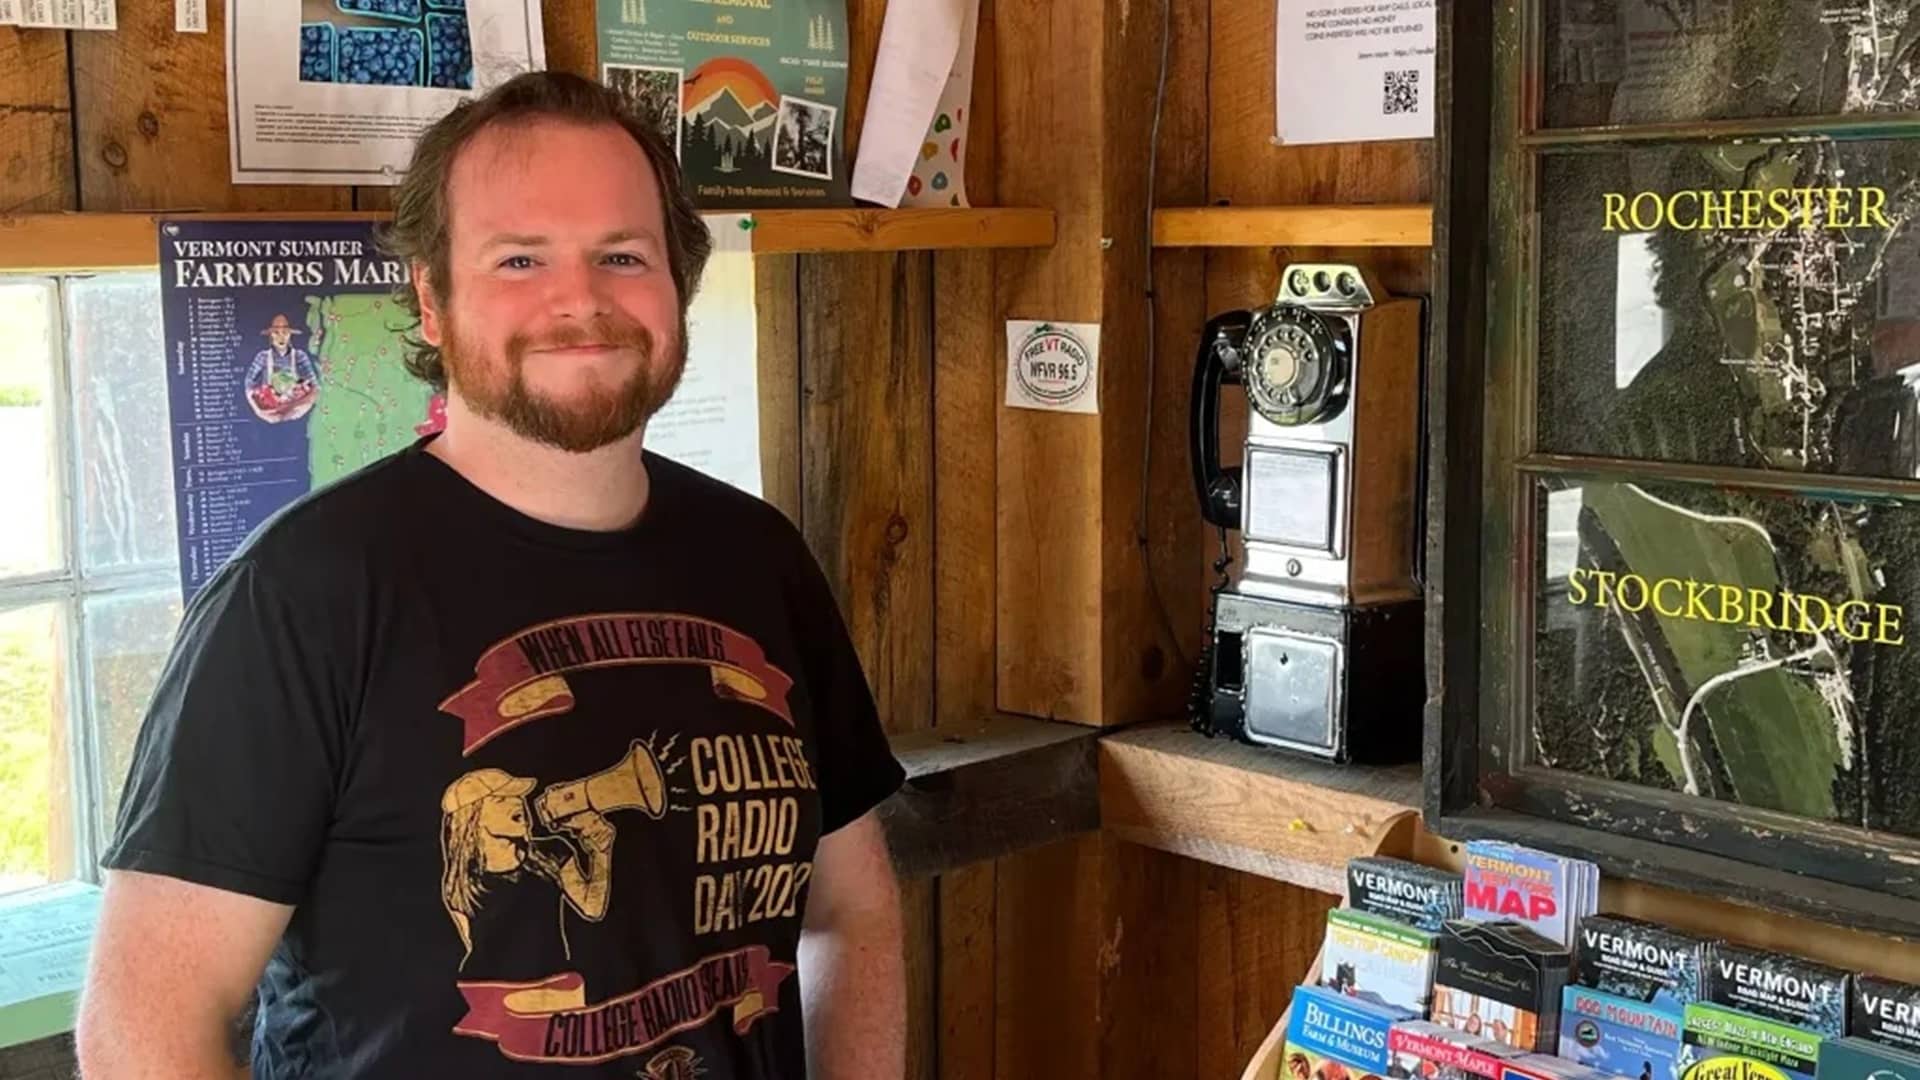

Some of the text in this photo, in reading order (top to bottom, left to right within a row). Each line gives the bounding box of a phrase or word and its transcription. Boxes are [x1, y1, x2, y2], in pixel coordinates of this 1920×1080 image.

[687, 30, 771, 47] OUTDOOR SERVICES
[1602, 186, 1890, 232] ROCHESTER
[173, 240, 363, 258] VERMONT SUMMER
[174, 258, 324, 288] FARMERS
[1045, 338, 1060, 351] VT
[1567, 567, 1904, 645] STOCKBRIDGE
[516, 622, 591, 675] WHEN
[588, 620, 629, 660] ALL
[625, 620, 672, 657] ELSE
[691, 734, 817, 796] COLLEGE
[697, 797, 798, 863] RADIO
[1353, 869, 1440, 904] VERMONT
[1466, 855, 1552, 881] VERMONT
[694, 868, 754, 936] DAY
[1466, 881, 1557, 921] MAP
[1584, 928, 1688, 970] VERMONT
[1719, 958, 1832, 1004] VERMONT
[544, 1000, 641, 1056] COLLEGE
[639, 973, 700, 1041] RADIO
[1303, 1001, 1385, 1049] BILLINGS
[1575, 996, 1678, 1037] DOG MOUNTAIN
[1335, 1039, 1380, 1065] MUSEUM
[1396, 1033, 1496, 1075] VERMONT MAPLE
